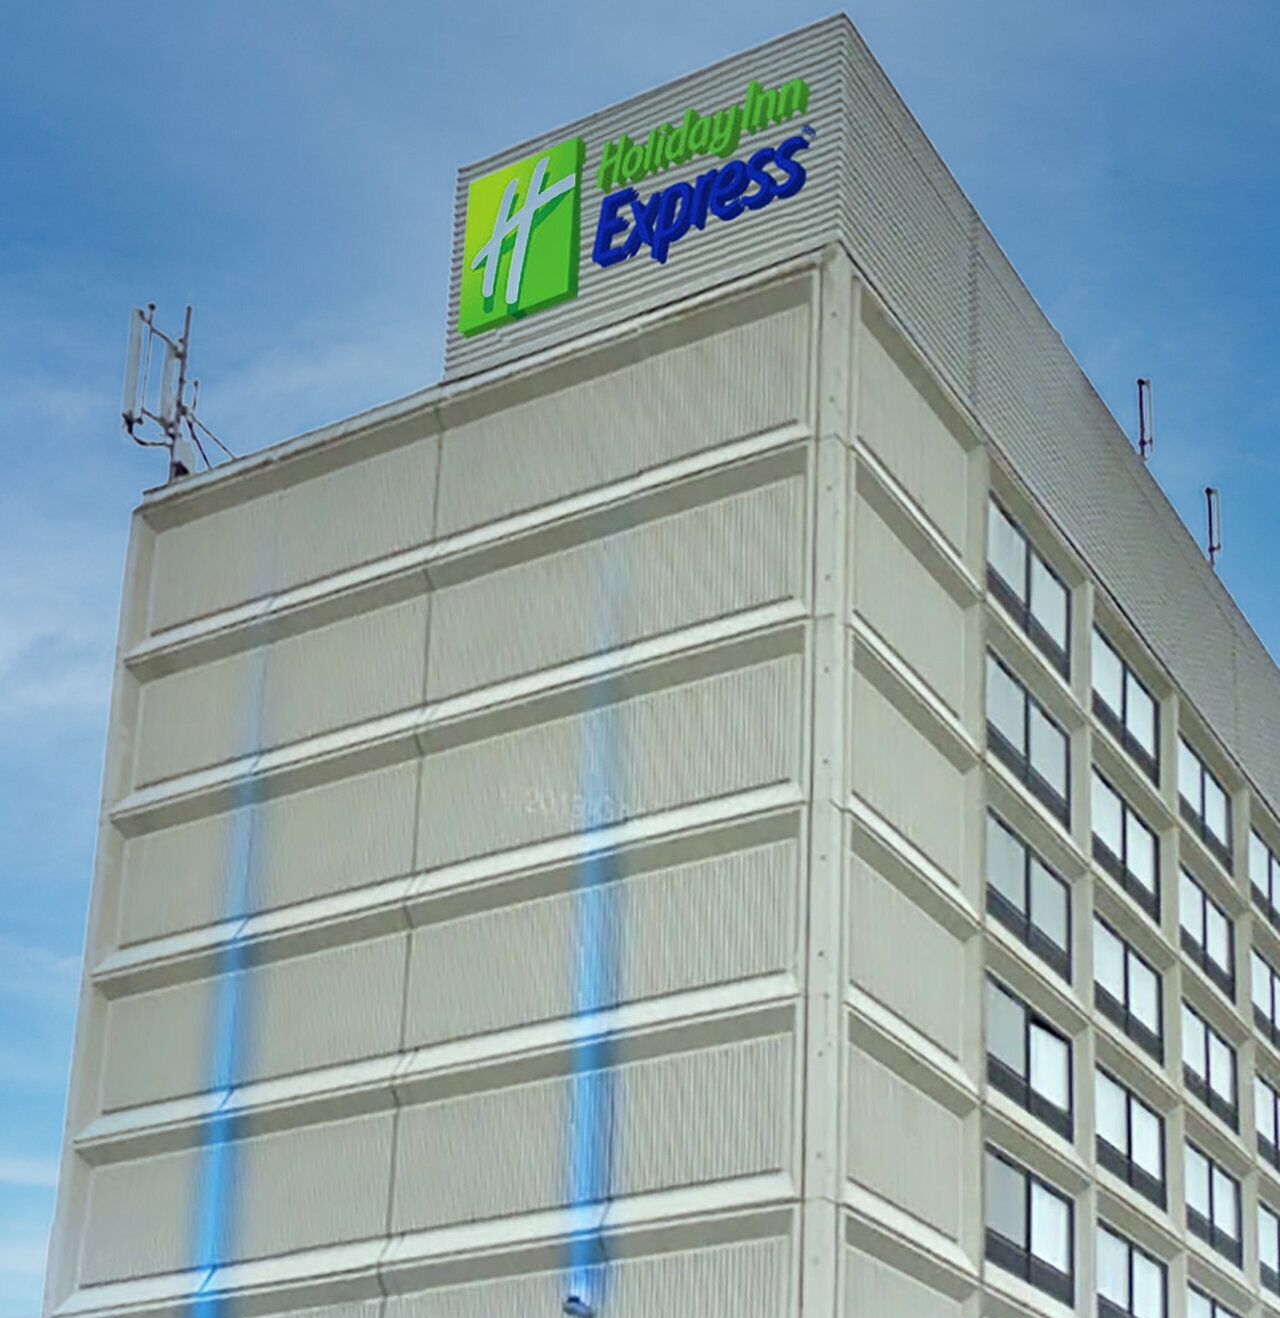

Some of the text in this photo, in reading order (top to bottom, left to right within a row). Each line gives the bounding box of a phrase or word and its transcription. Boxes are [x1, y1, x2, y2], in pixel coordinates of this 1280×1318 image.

[596, 78, 811, 194] Holiday Inn
[592, 136, 811, 268] Express
